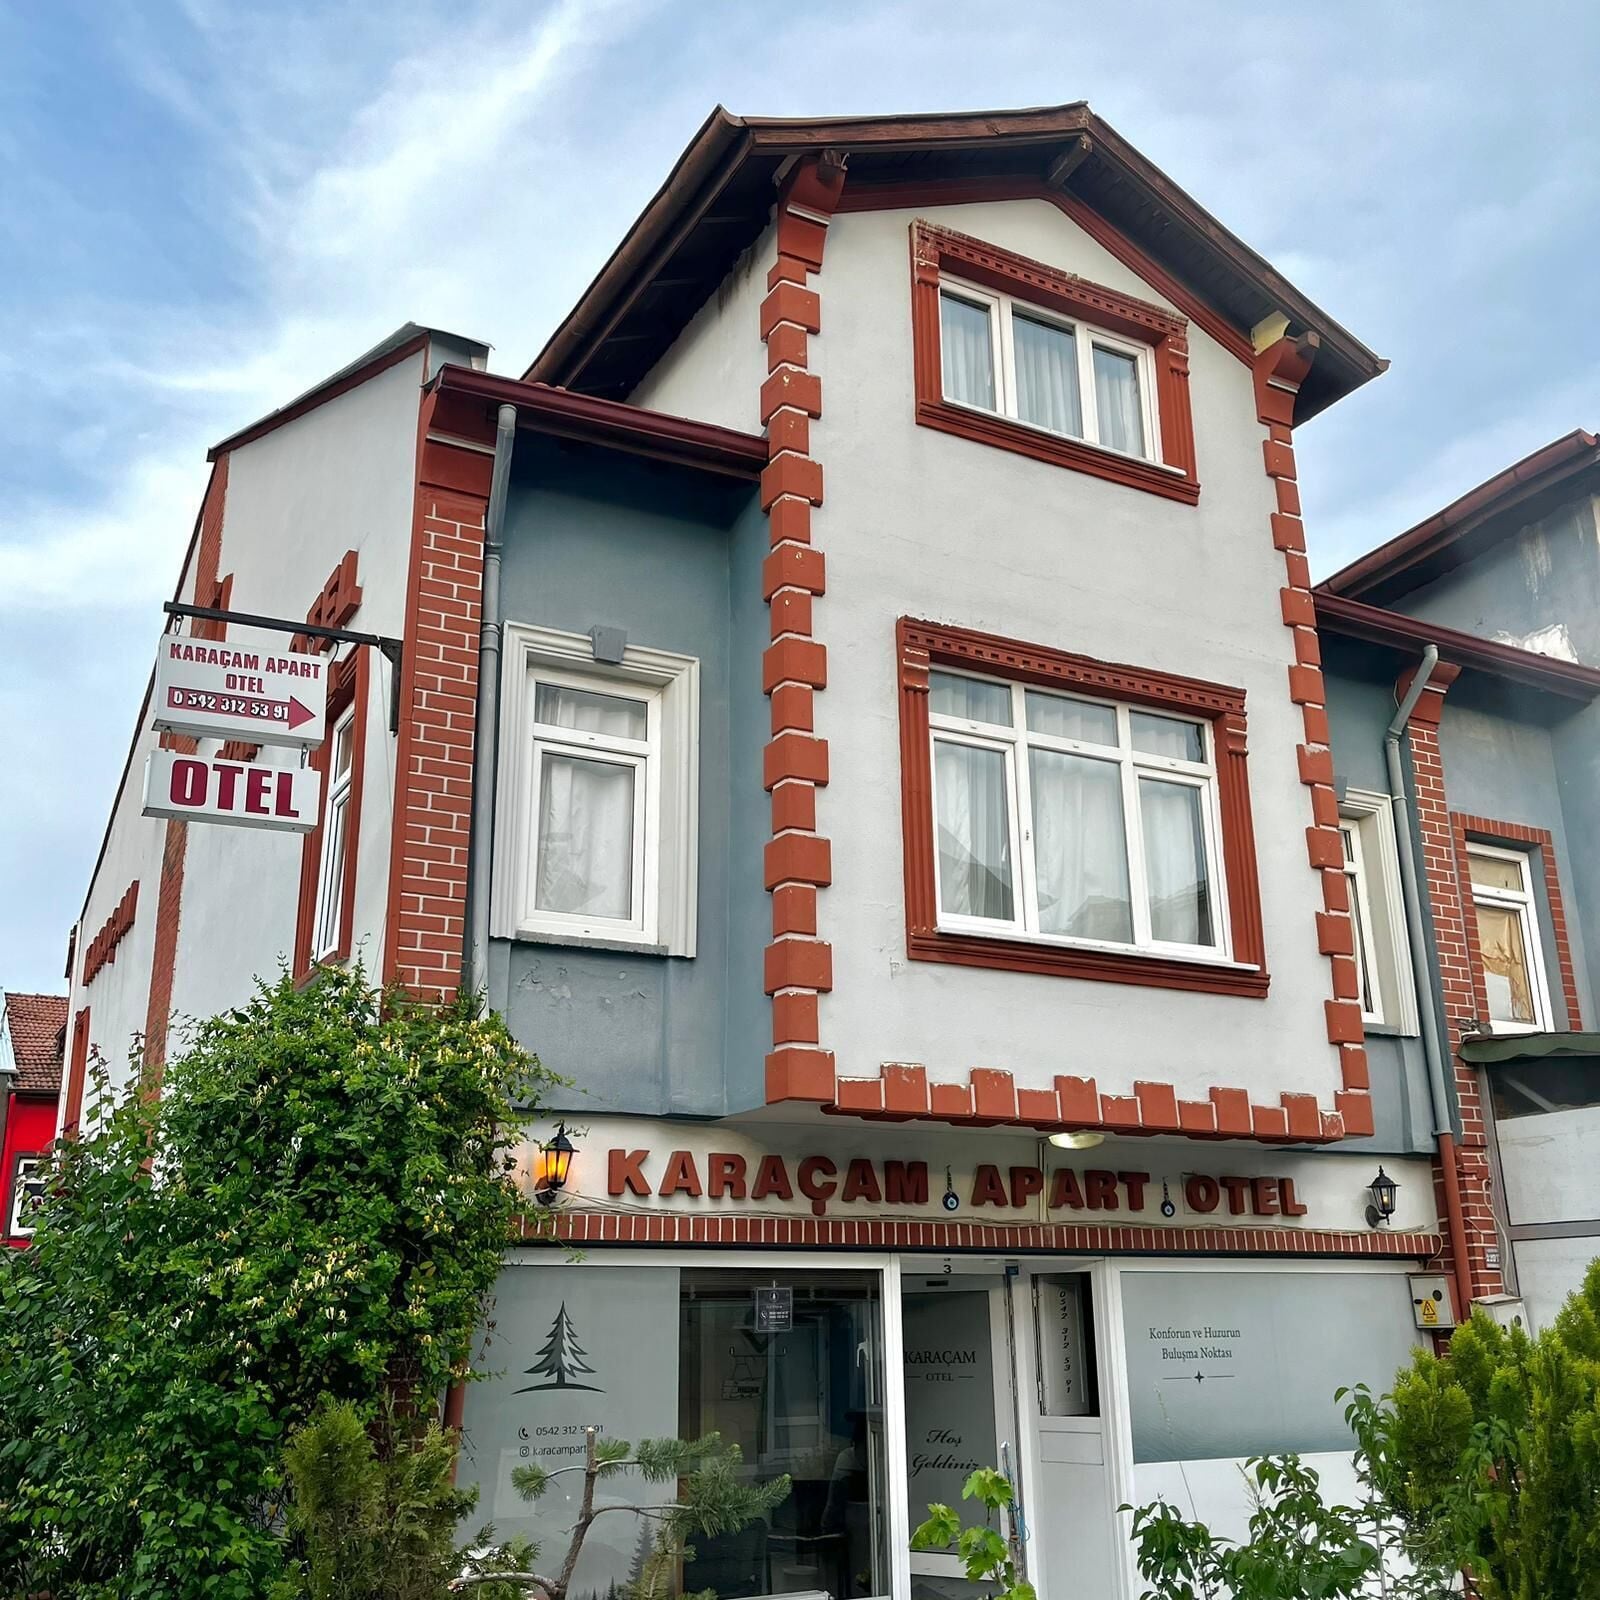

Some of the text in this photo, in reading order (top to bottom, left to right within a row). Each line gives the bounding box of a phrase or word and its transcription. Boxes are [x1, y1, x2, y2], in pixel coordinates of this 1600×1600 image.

[170, 643, 321, 679] KARAÇAM APART
[225, 673, 265, 694] OTEL
[173, 690, 290, 721] 0 542 312 53 91
[169, 759, 300, 818] OTEL
[607, 1149, 1308, 1216] KARAÇAM APART OTEL
[943, 1264, 952, 1274] 3
[1061, 1327, 1069, 1349] 312
[1149, 1327, 1191, 1339] Konforun
[1203, 1327, 1241, 1338] Huzurun
[904, 1351, 976, 1367] KARAÇAM
[1162, 1346, 1232, 1362] Buluşma Noktası
[926, 1373, 954, 1381] OTEL
[535, 1425, 604, 1436] 0542 312 5 91
[926, 1429, 961, 1447] Hoş
[911, 1453, 978, 1480] Geldiniz
